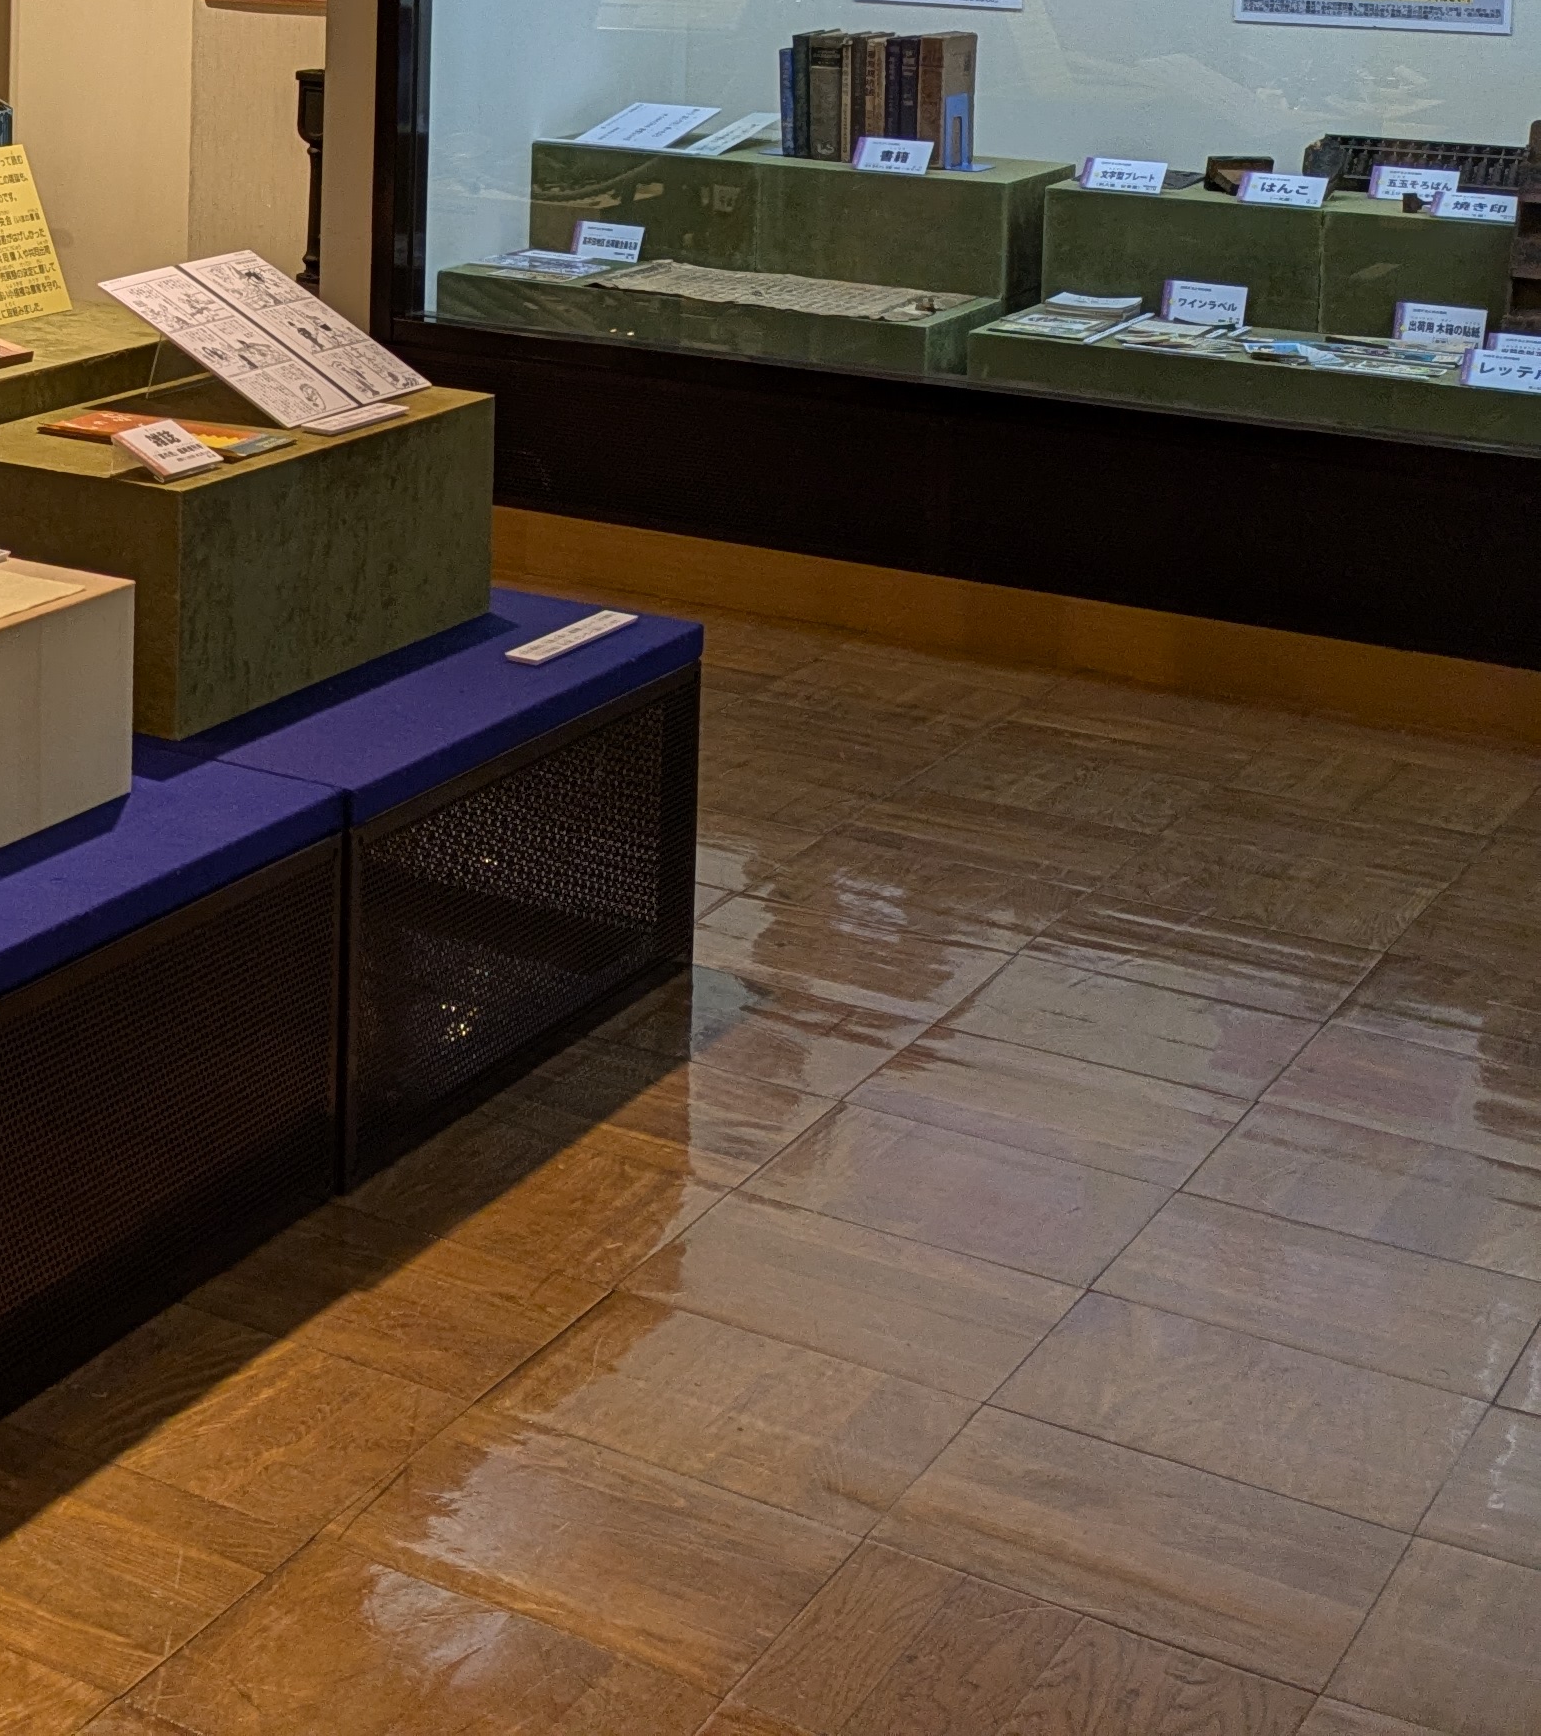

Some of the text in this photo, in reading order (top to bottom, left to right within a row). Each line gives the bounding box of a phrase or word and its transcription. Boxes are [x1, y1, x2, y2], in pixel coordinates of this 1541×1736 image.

[1260, 181, 1310, 196] はんこ
[1451, 200, 1508, 214] 焼き印
[1177, 298, 1238, 312] ワインラベル
